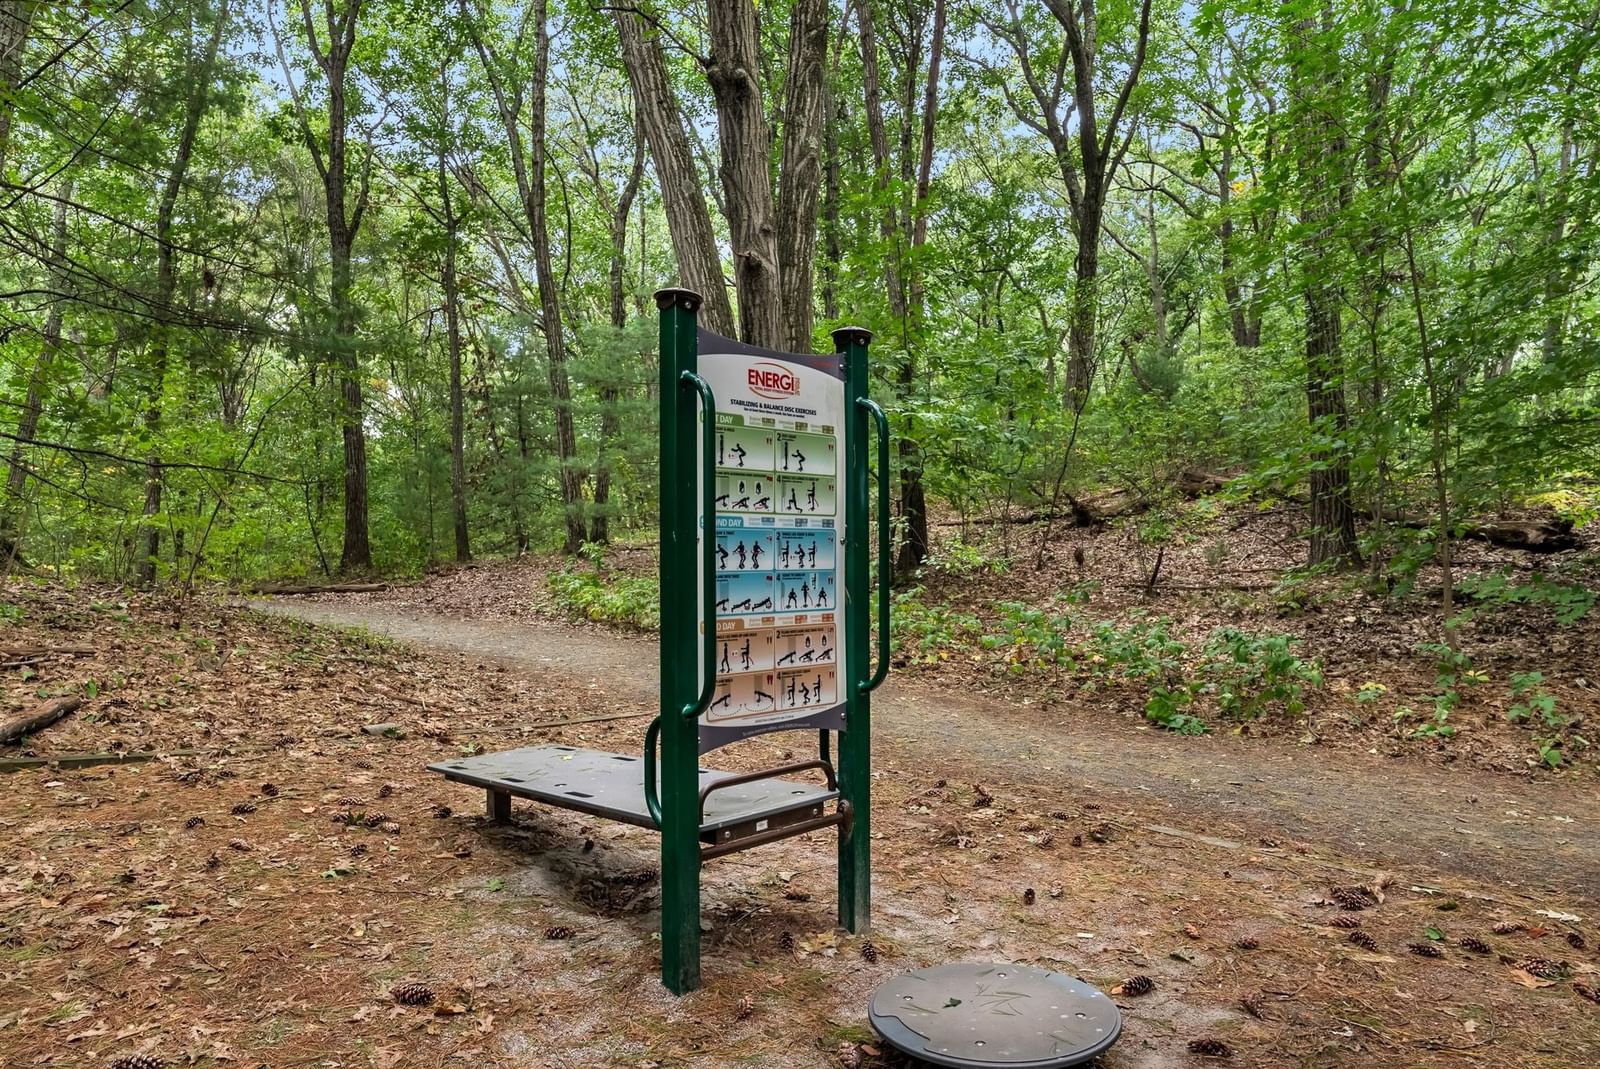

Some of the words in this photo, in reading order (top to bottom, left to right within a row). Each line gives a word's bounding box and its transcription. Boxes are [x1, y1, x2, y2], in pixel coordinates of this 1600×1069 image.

[730, 399, 758, 408] STABILIZING
[764, 403, 783, 411] BALANCE
[720, 415, 734, 424] DAY
[777, 433, 781, 441] 2
[728, 519, 742, 527] DAY
[776, 532, 780, 540] 2
[723, 621, 736, 629] DAY
[776, 630, 780, 639] 2
